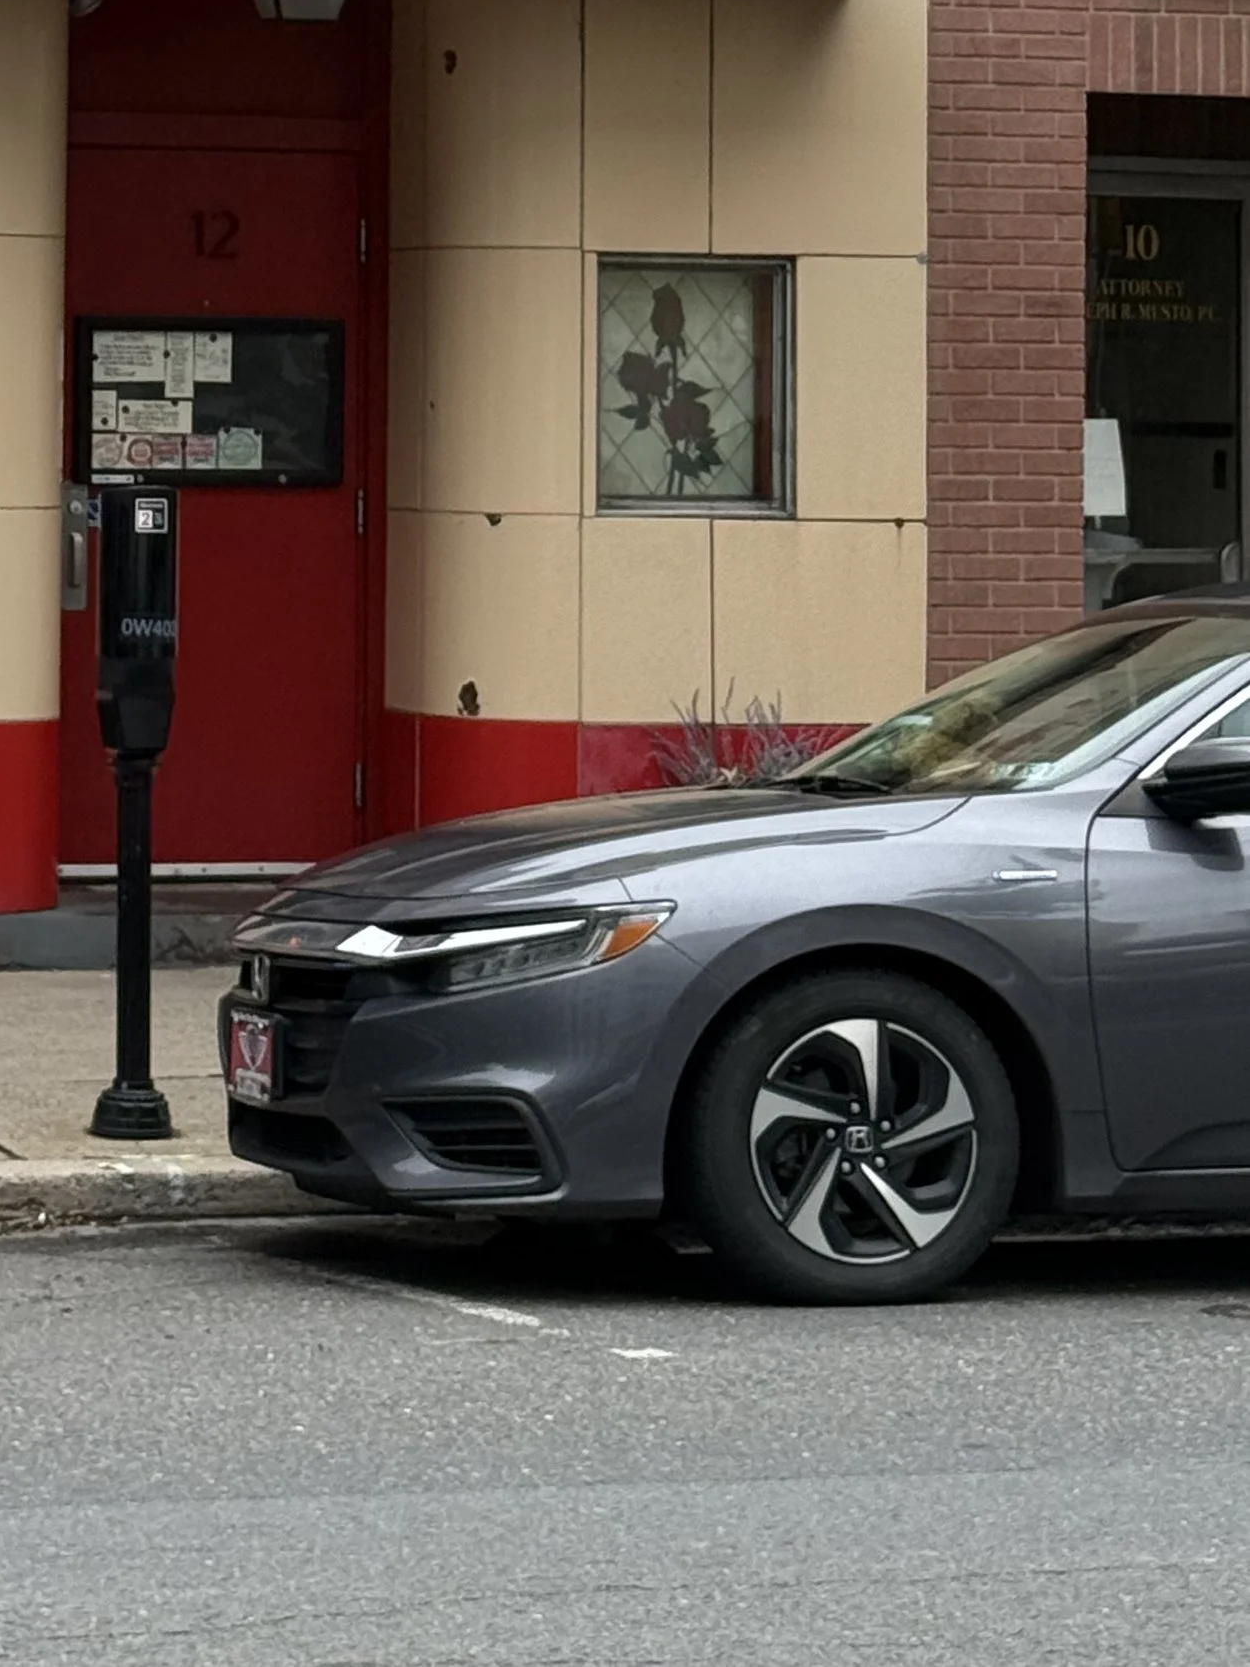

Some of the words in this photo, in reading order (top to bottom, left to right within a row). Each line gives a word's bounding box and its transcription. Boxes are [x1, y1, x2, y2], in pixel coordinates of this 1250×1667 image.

[190, 209, 240, 260] 12
[1123, 223, 1161, 261] 10
[1098, 278, 1186, 298] ATTORNEY
